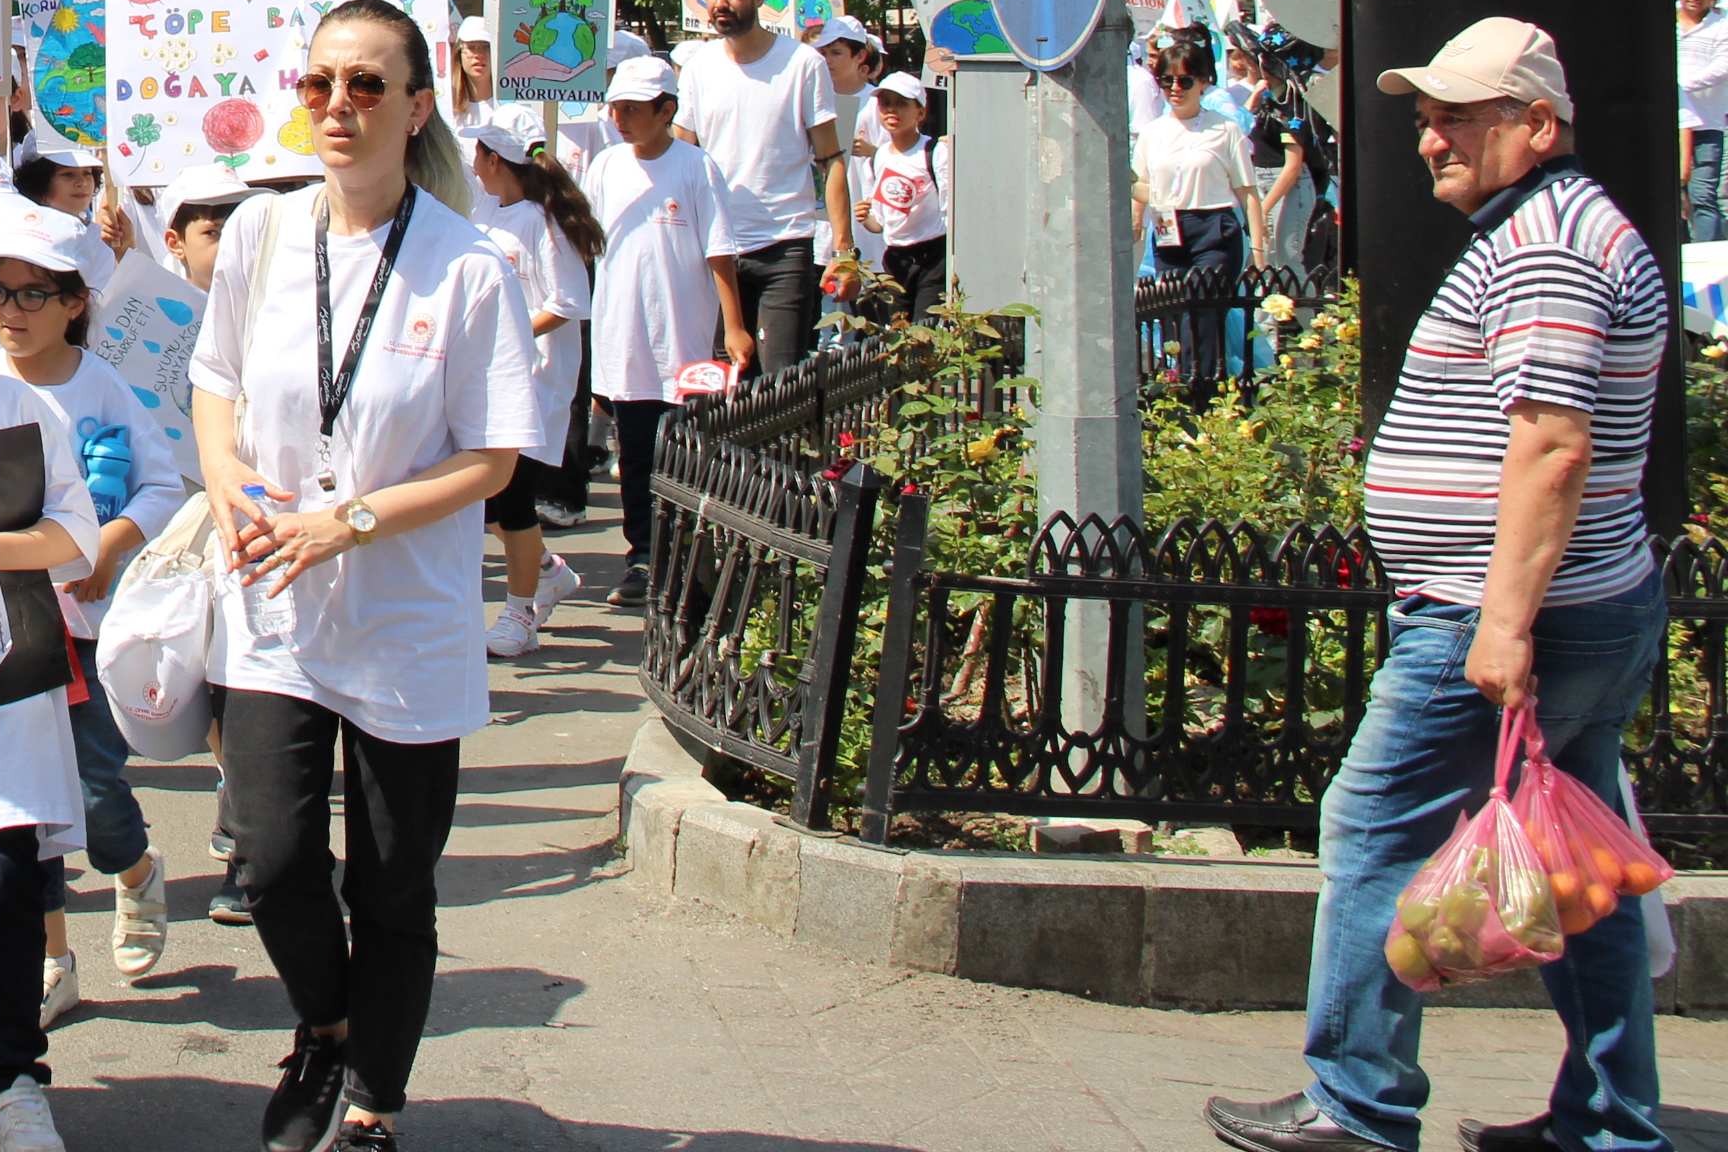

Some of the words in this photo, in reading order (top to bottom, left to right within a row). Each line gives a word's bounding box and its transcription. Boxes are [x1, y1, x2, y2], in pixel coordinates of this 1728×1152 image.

[21, 0, 57, 19] KORU
[136, 7, 231, 40] ÇÖPE
[685, 15, 701, 29] BİR
[115, 71, 257, 101] DOĞAYA
[499, 77, 532, 88] ONU
[515, 88, 606, 103] KORUYALIM
[115, 296, 143, 329] DAN
[154, 339, 181, 393] SUYUNU
